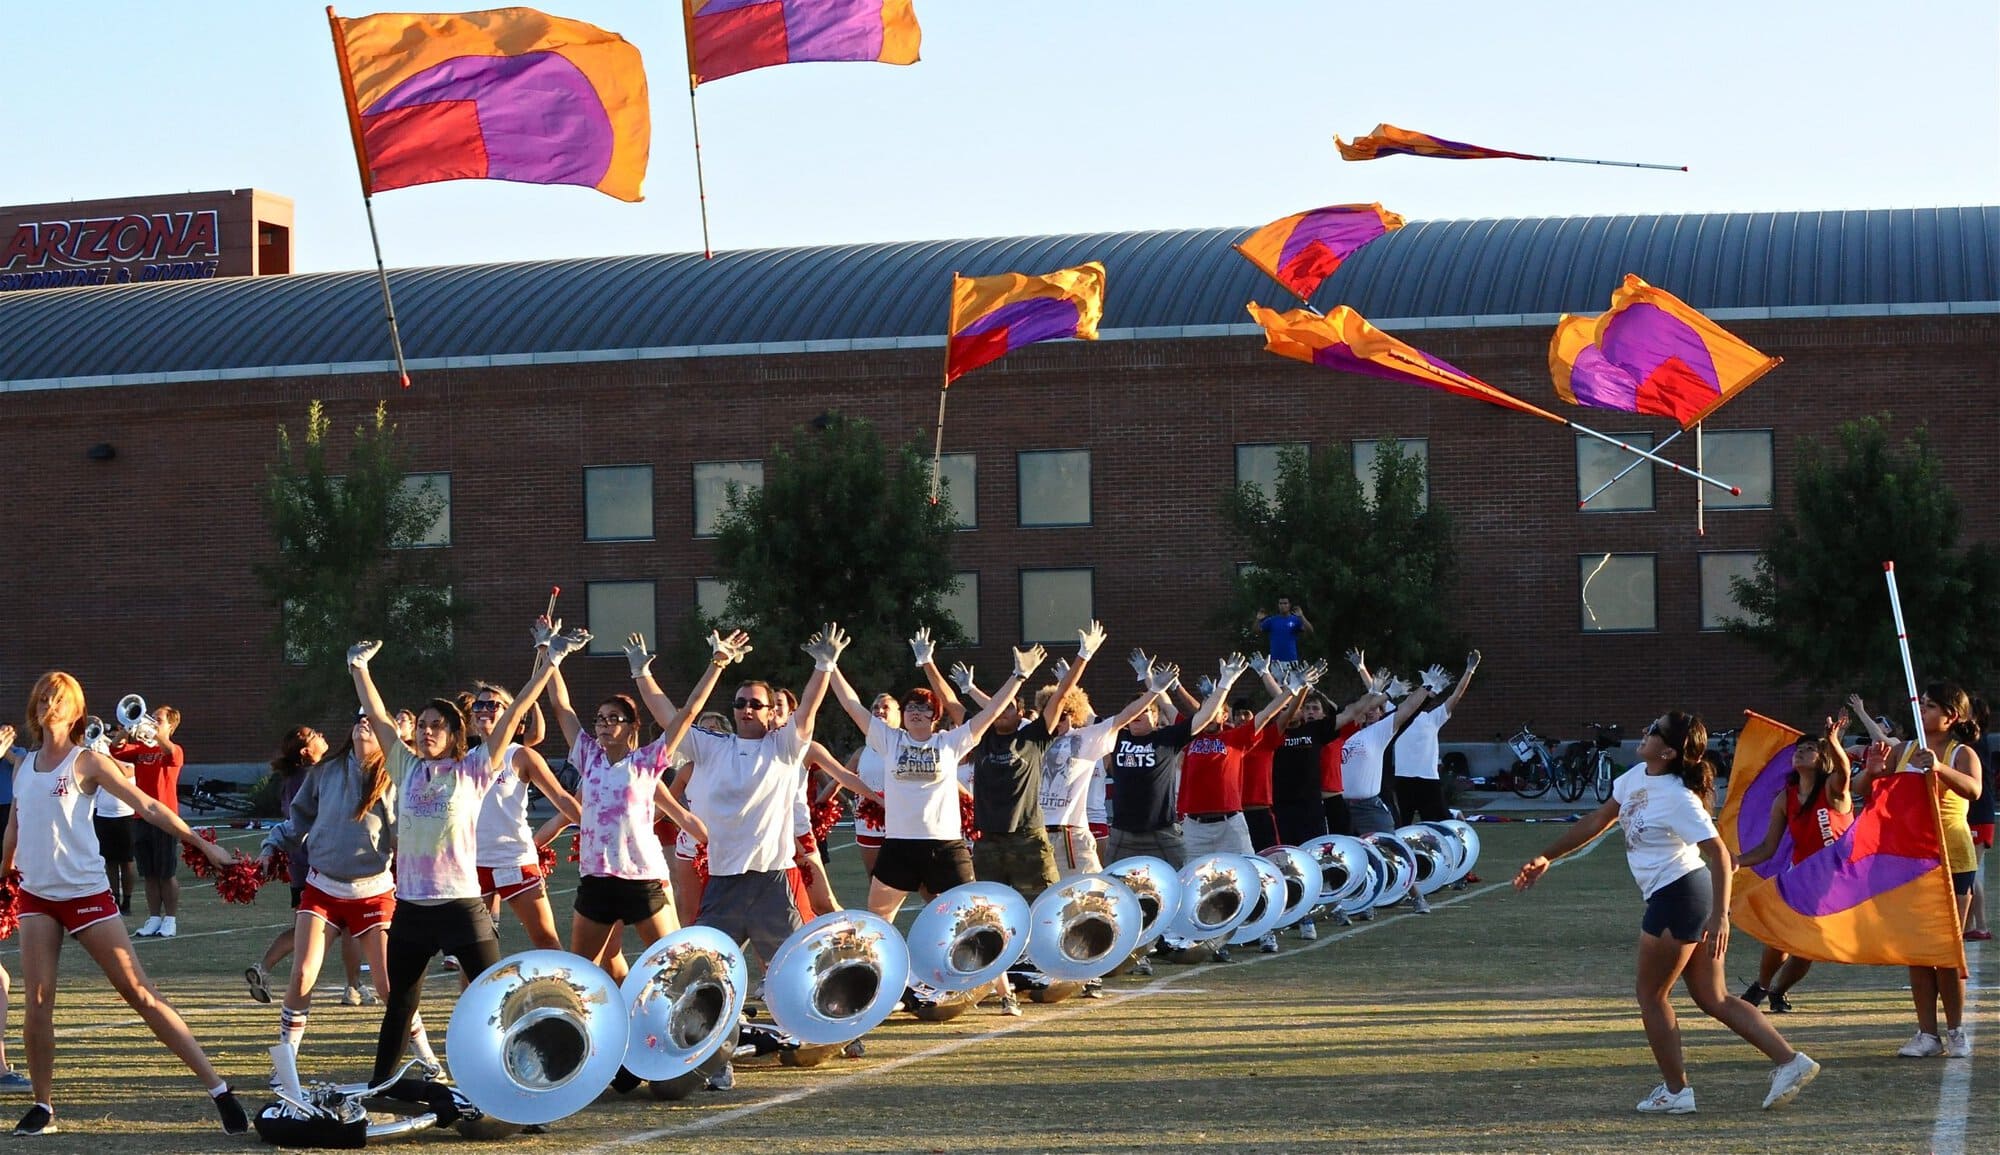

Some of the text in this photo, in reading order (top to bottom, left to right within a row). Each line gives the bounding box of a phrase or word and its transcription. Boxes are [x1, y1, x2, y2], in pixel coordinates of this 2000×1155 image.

[0, 209, 220, 270] ARIZONA
[0, 260, 219, 291] SWIMMING & DIVING
[1116, 752, 1156, 768] CATS
